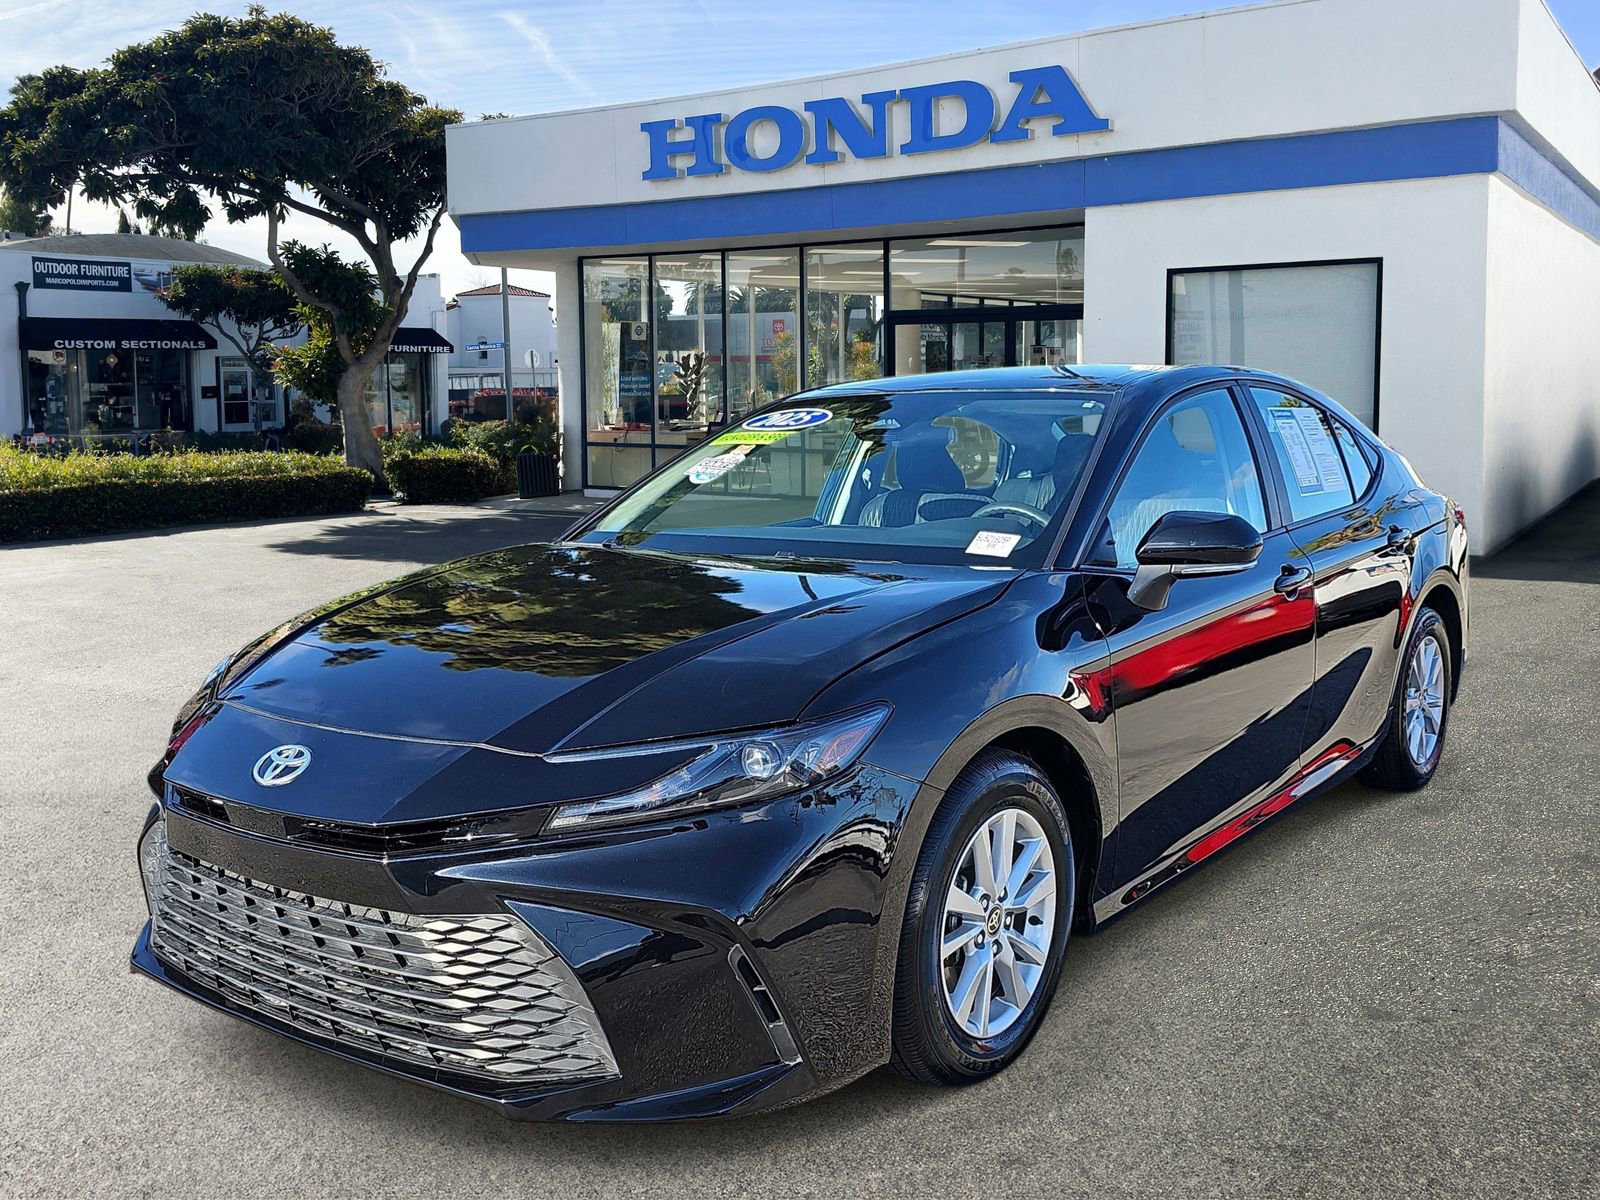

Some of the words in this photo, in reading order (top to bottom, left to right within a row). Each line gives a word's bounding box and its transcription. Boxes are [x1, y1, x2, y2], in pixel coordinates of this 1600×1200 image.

[640, 65, 1111, 181] HONDA
[34, 261, 79, 275] OUTDOOR
[80, 264, 130, 277] FURNITURE
[45, 277, 119, 287] MARCOPOLOIMPORTS.COM
[54, 339, 116, 349] CUSTOM
[121, 340, 206, 349] SECTIONALS
[388, 344, 450, 353] FURNITURE
[748, 410, 825, 427] 2025
